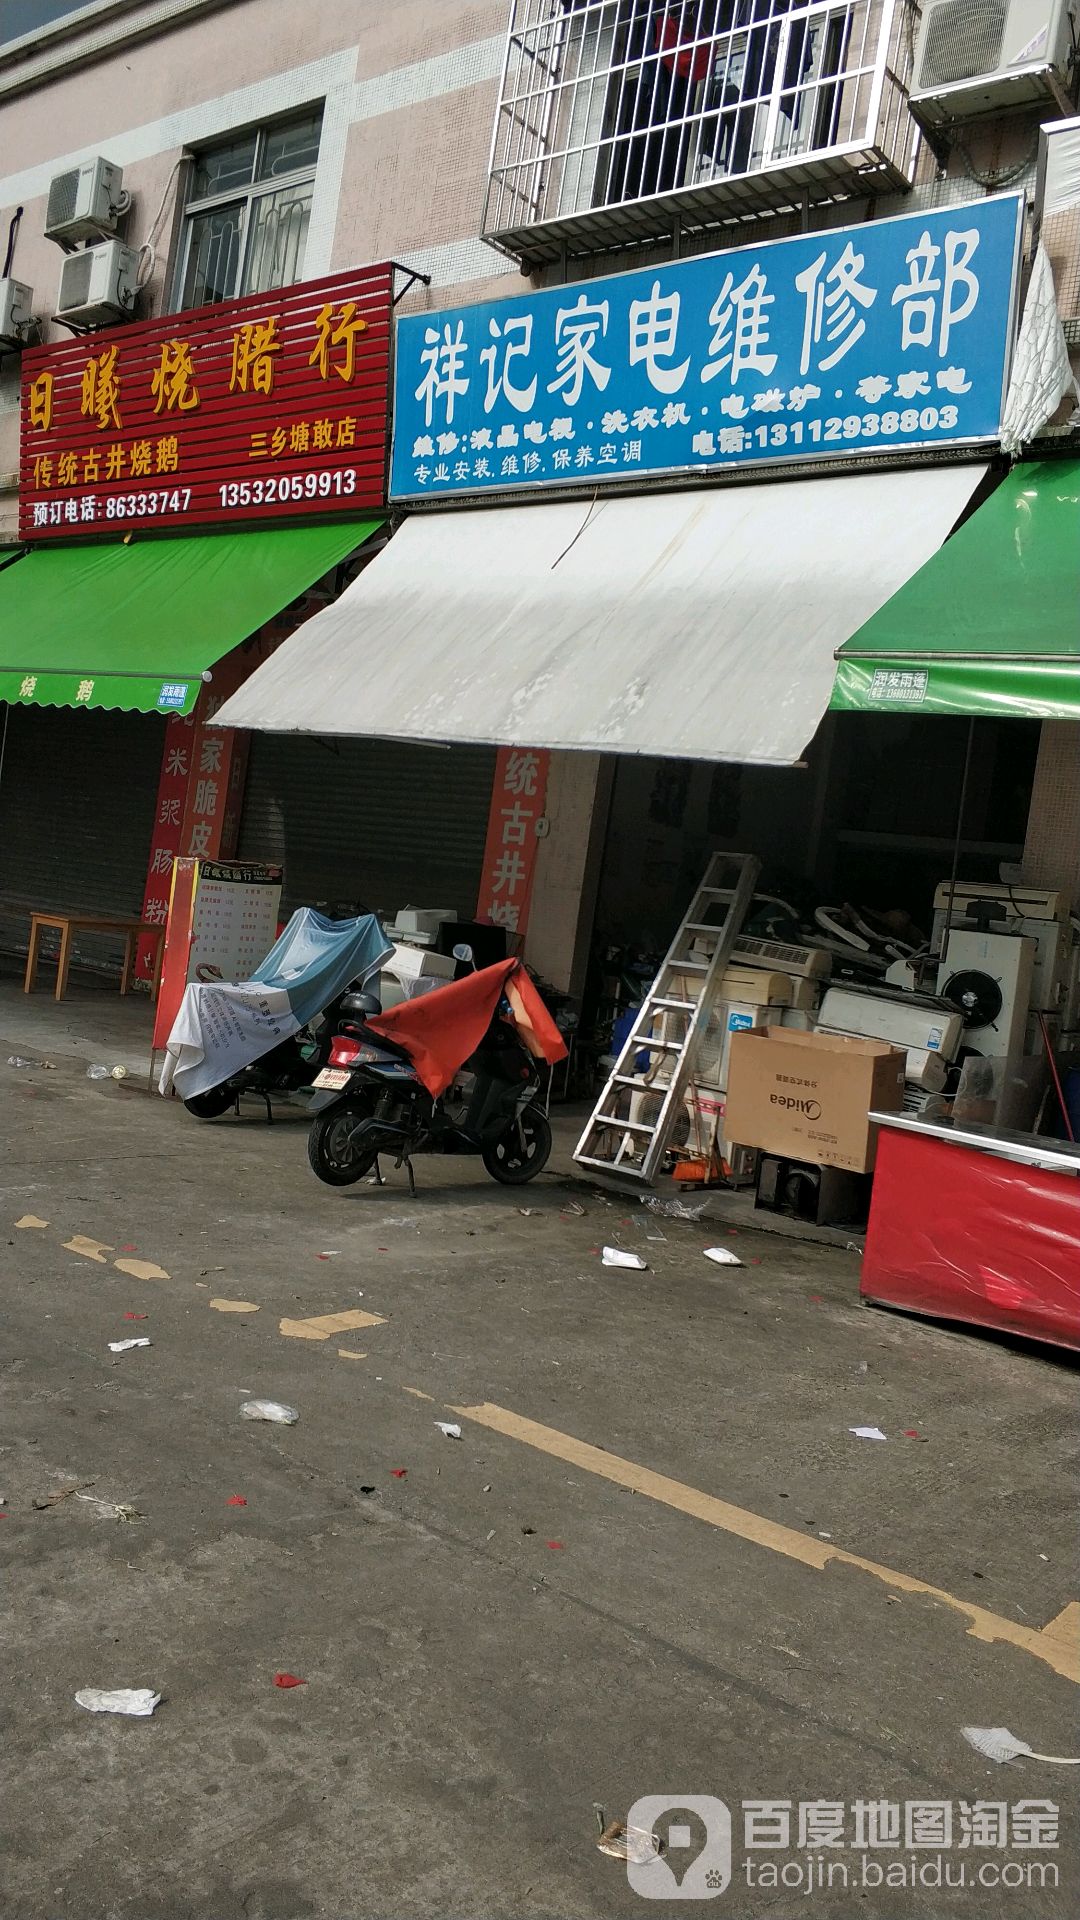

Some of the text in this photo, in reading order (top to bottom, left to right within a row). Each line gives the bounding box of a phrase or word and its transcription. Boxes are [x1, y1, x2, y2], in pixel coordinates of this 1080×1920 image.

[415, 228, 980, 427] 祥记家电维修部
[33, 436, 179, 489] 传统古井烧鹅
[249, 416, 357, 457] 三乡塘敢店
[33, 469, 357, 527] 预订电话:86333747 13532059913
[187, 697, 225, 858] 家脆皮
[769, 1093, 822, 1120] Midea
